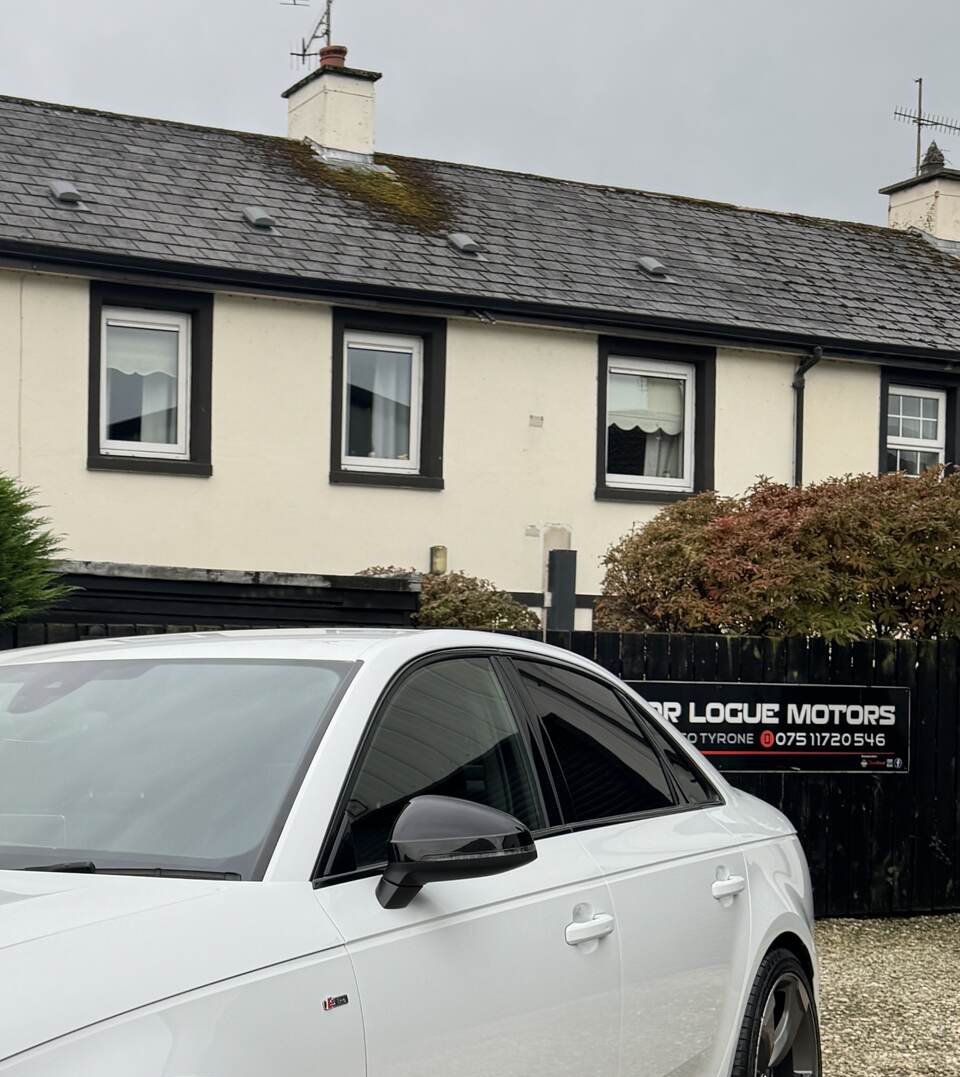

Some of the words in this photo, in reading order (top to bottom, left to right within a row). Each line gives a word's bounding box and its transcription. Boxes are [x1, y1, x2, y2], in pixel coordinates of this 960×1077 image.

[689, 702, 780, 724] LOGUE
[787, 703, 896, 726] MOTORS
[680, 733, 698, 744] O
[700, 733, 755, 744] TYRONE
[775, 732, 807, 747] 075
[854, 733, 886, 747] 546
